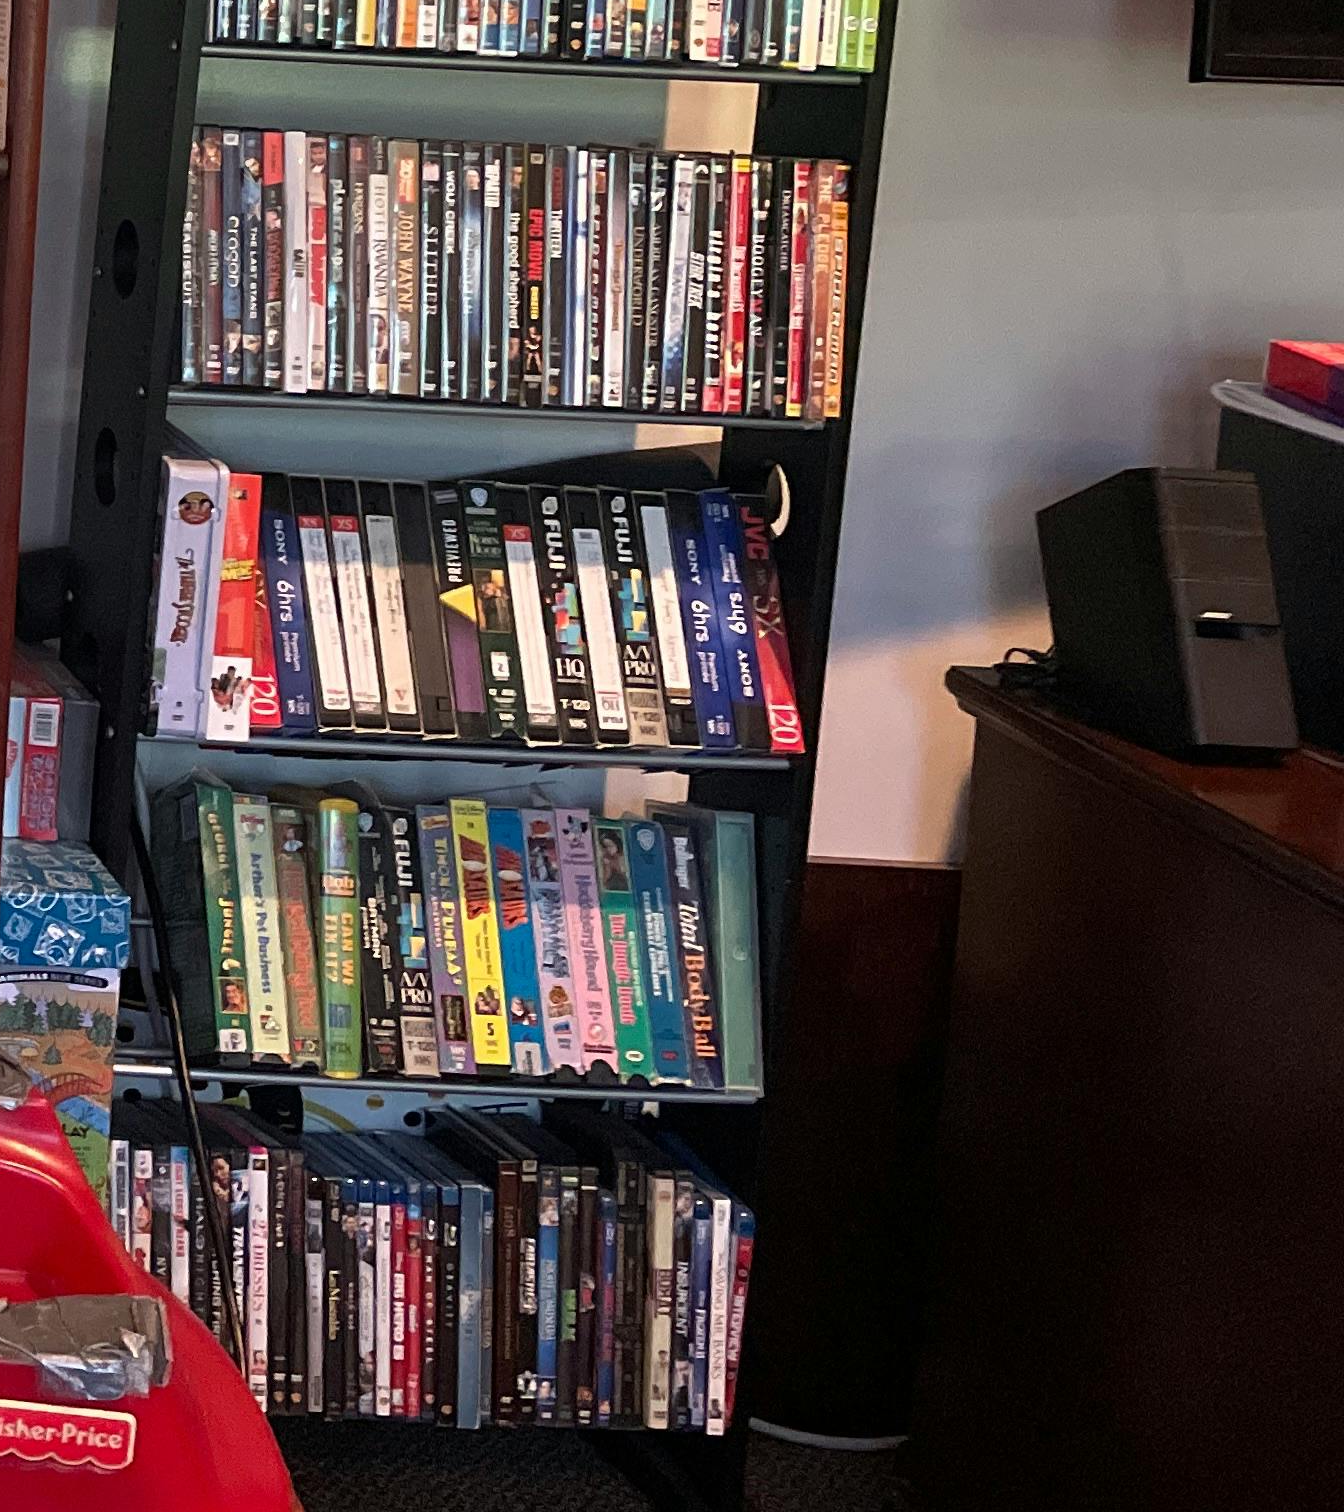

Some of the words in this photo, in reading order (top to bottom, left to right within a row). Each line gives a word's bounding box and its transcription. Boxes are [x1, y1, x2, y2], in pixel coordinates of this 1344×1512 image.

[820, 175, 832, 201] THE
[249, 227, 258, 247] THE
[397, 210, 413, 253] JOHN
[445, 210, 455, 254] CREEK
[509, 212, 520, 232] the
[528, 208, 543, 237] EPIC
[550, 209, 562, 258] THIRTEEN
[779, 189, 792, 271] DREAMCATCHER
[815, 213, 830, 273] PLEDGE
[181, 211, 193, 306] SEABISCUIT
[249, 251, 257, 280] LAST
[372, 239, 387, 299] RWANDA
[423, 223, 439, 316] SLITHER
[507, 235, 520, 266] good
[527, 240, 542, 281] MOVIE
[396, 257, 413, 313] WAYNE
[631, 225, 645, 327] UNDERWORLD
[249, 287, 257, 319] STAND
[507, 270, 520, 329] shepherd
[273, 519, 288, 566] SONY
[543, 519, 567, 570] FUJI
[614, 517, 633, 562] FUJI
[740, 506, 769, 560] JVC
[685, 539, 702, 586] SONY
[276, 580, 296, 622] 6hrs
[690, 599, 710, 642] 6hrs
[728, 592, 748, 634] 6hrs
[250, 672, 278, 715] 120
[736, 649, 755, 697] SONY
[768, 702, 798, 744] 120
[394, 839, 413, 887] FUJI
[673, 837, 694, 889] Bollinger
[255, 911, 268, 933] Pet
[324, 915, 338, 946] FIX
[340, 911, 354, 953] CAN
[367, 897, 382, 959] BATMAN
[678, 900, 704, 952] Total
[257, 936, 273, 994] Business
[325, 952, 339, 983] IT?
[684, 954, 710, 1012] Body
[694, 1015, 716, 1058] Ball
[195, 1197, 205, 1250] HALO
[252, 1220, 267, 1240] 27
[252, 1245, 266, 1312] DRESSES
[675, 1261, 690, 1337] INSURGENT
[393, 1301, 405, 1342] HERO
[727, 1294, 745, 1361] INTERVIEW
[711, 1339, 724, 1380] BANKS
